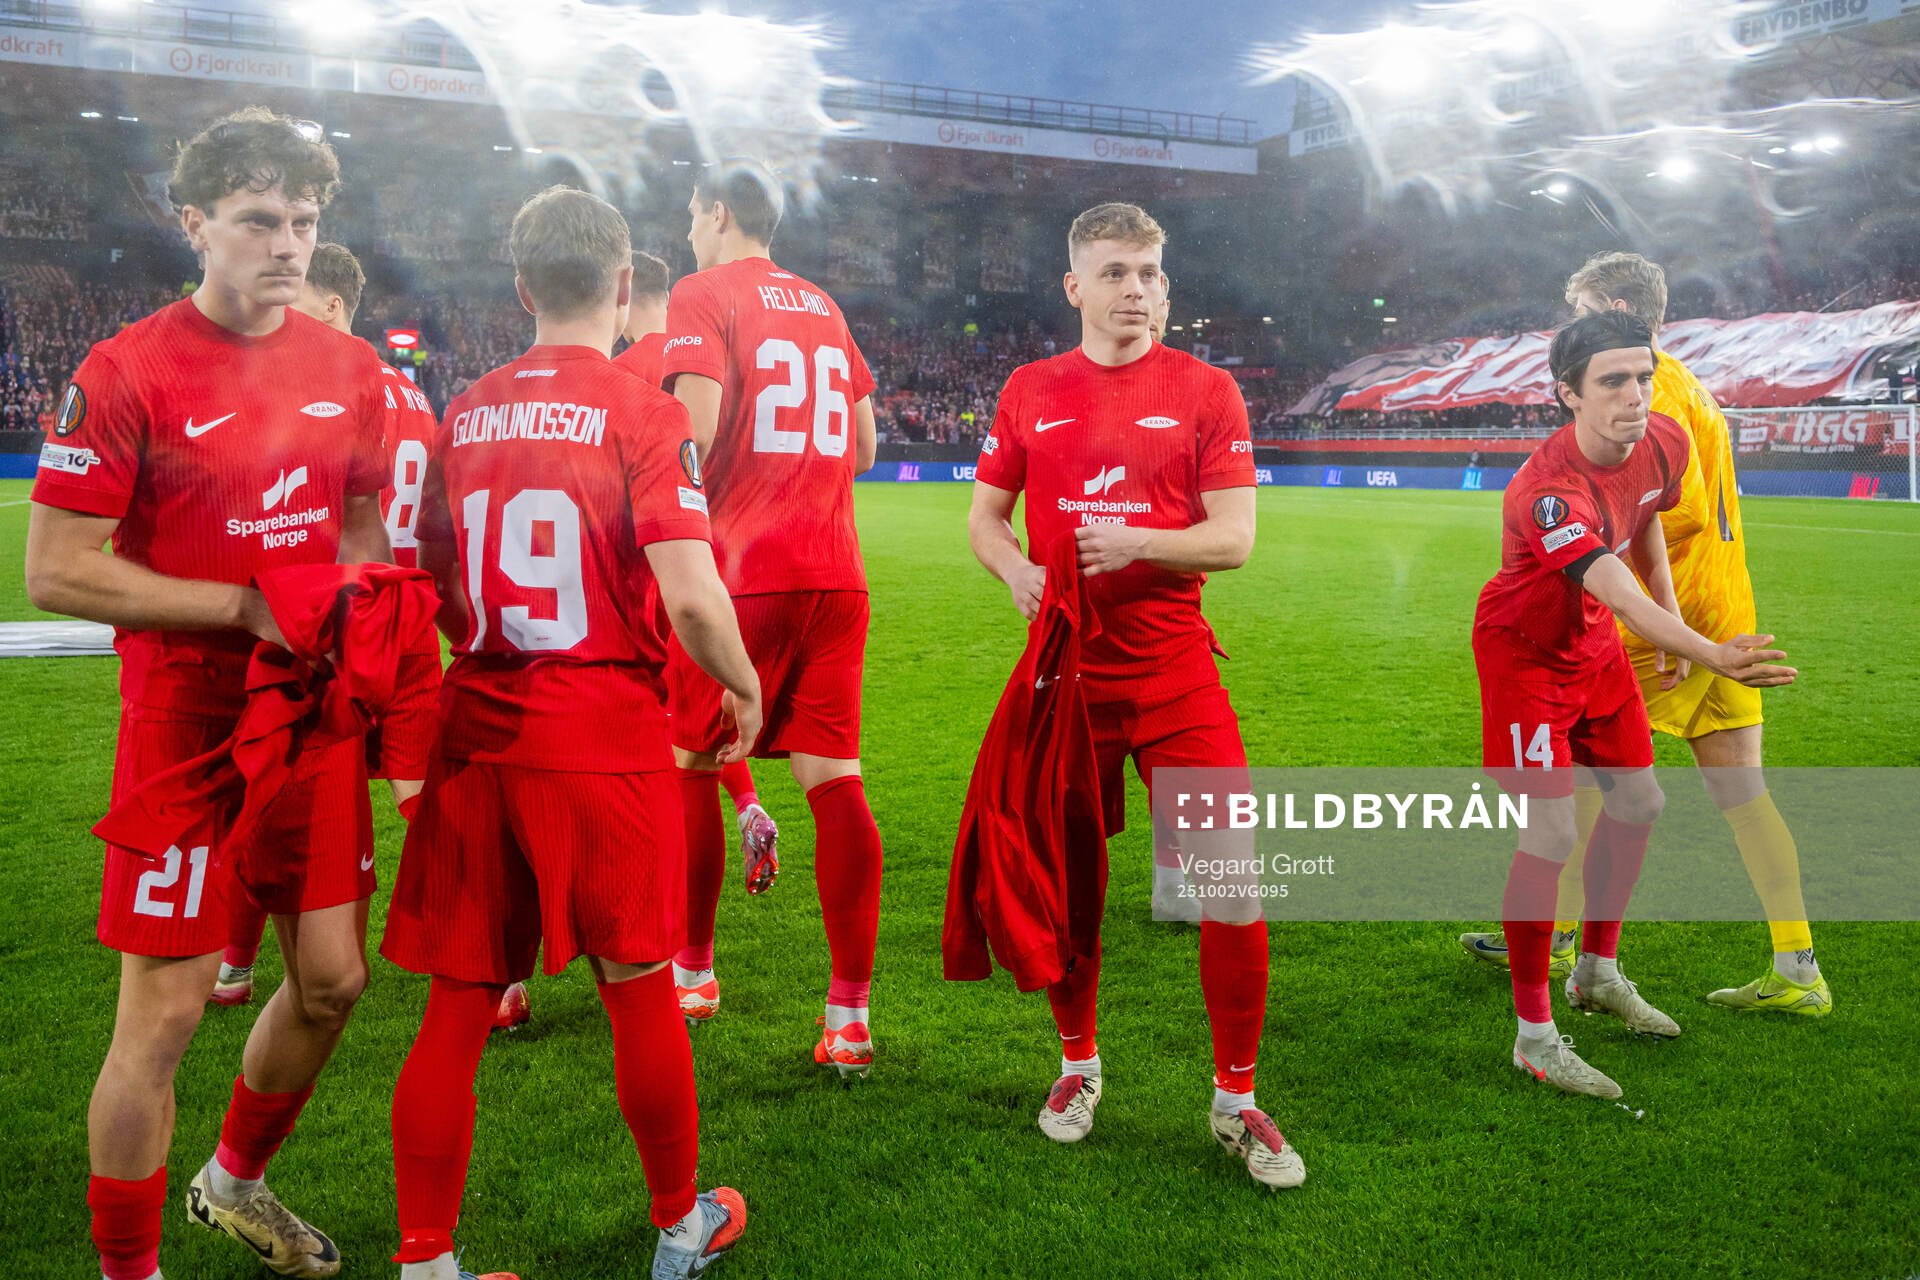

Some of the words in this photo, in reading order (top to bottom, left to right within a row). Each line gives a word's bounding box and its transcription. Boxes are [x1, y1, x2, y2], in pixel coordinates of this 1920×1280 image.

[197, 53, 293, 78] Fjordkraft
[413, 73, 490, 97] Fjordkra
[957, 127, 1025, 147] Fjordkraft
[757, 285, 830, 317] HELLAND
[663, 335, 703, 357] OTMOB
[311, 405, 339, 415] BRANN
[754, 338, 849, 458] 26
[452, 401, 608, 448] GUDMUNDSSON
[1792, 412, 1869, 443] BGG
[898, 464, 920, 481] ALL
[1256, 469, 1273, 483] EFA
[1366, 470, 1398, 487] UEFA
[1462, 471, 1483, 490] ALL
[385, 439, 428, 549] 8
[1057, 496, 1152, 514] Sparebanken
[226, 506, 329, 538] Sparebanken
[263, 529, 308, 550] Norge
[463, 489, 588, 652] 19
[1510, 722, 1554, 772] 14
[132, 844, 209, 918] 21
